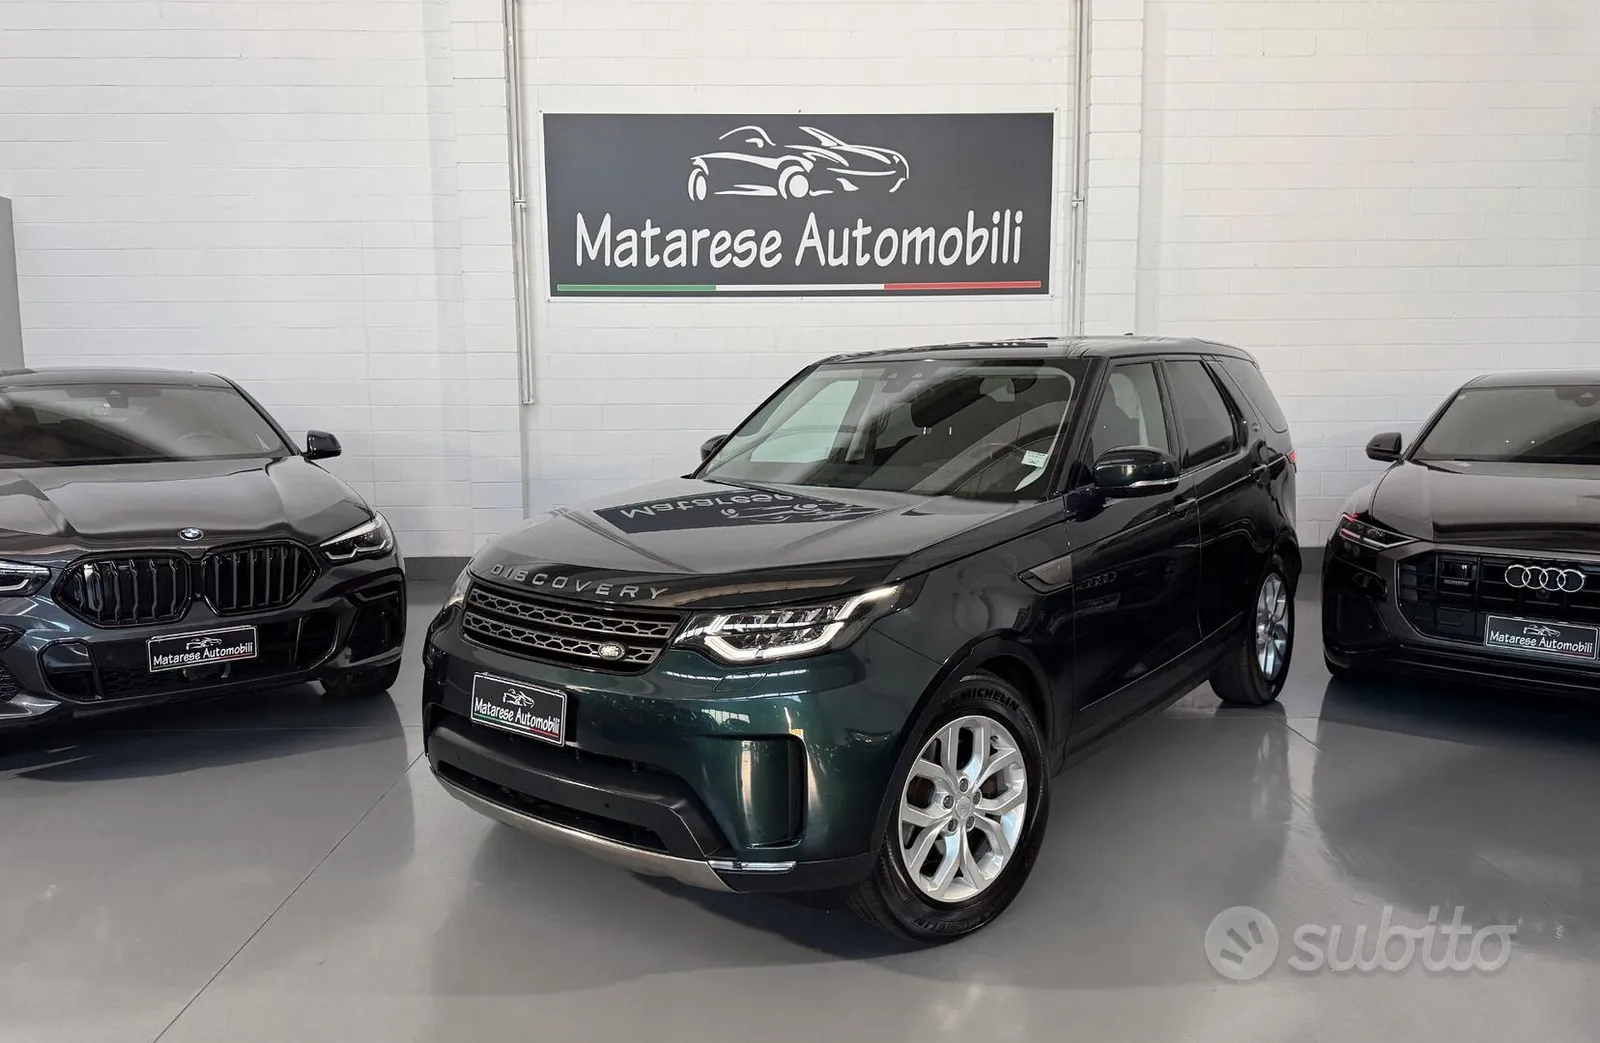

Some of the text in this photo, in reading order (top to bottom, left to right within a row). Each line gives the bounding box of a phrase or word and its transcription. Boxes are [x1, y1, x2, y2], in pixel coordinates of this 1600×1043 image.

[576, 208, 1024, 268] Matarese Automobili
[491, 564, 669, 599] DISCOVERY
[153, 642, 253, 666] Matarese Automobili
[1489, 630, 1593, 653] Matarese Automobili
[959, 687, 1019, 711] MICHELIN
[474, 696, 560, 735] Matarese Automobili
